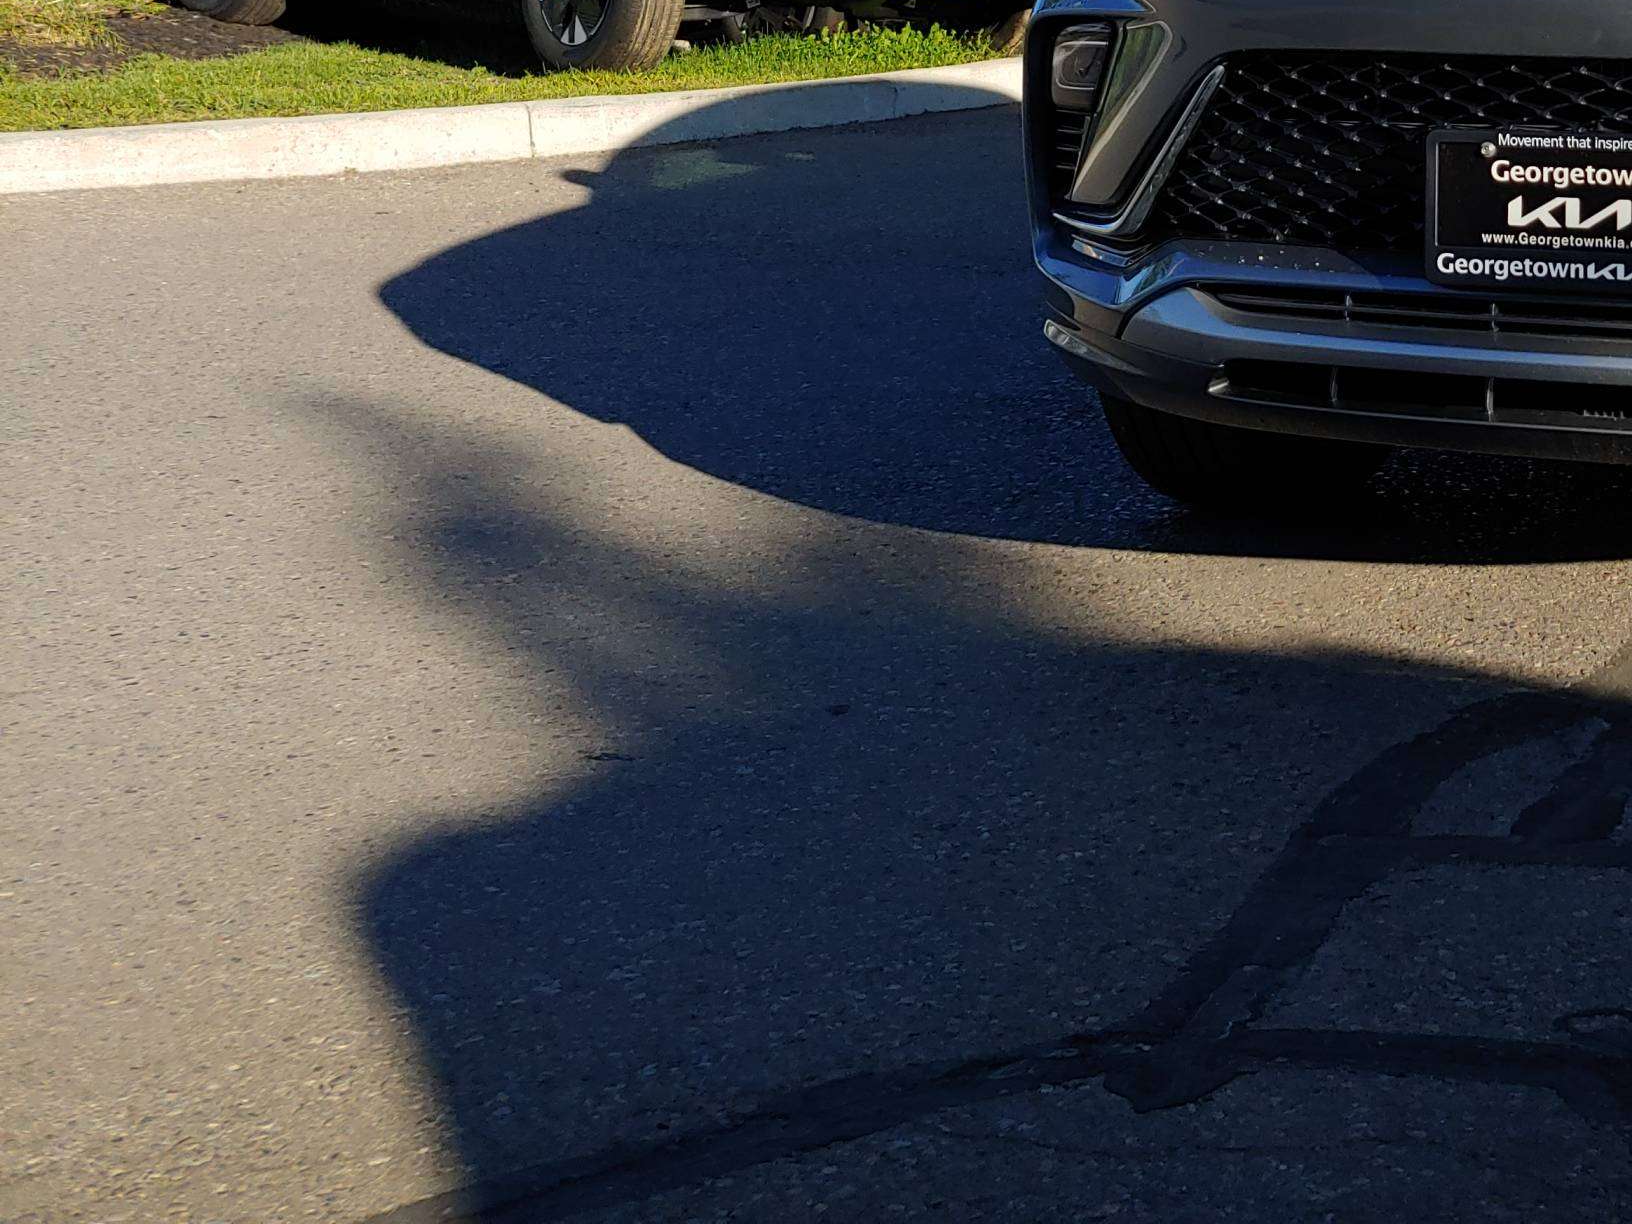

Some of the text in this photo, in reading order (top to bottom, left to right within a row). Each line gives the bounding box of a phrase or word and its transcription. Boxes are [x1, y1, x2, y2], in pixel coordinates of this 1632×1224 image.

[1498, 133, 1564, 148] Movement
[1566, 137, 1592, 150] that
[1507, 194, 1632, 231] KIA
